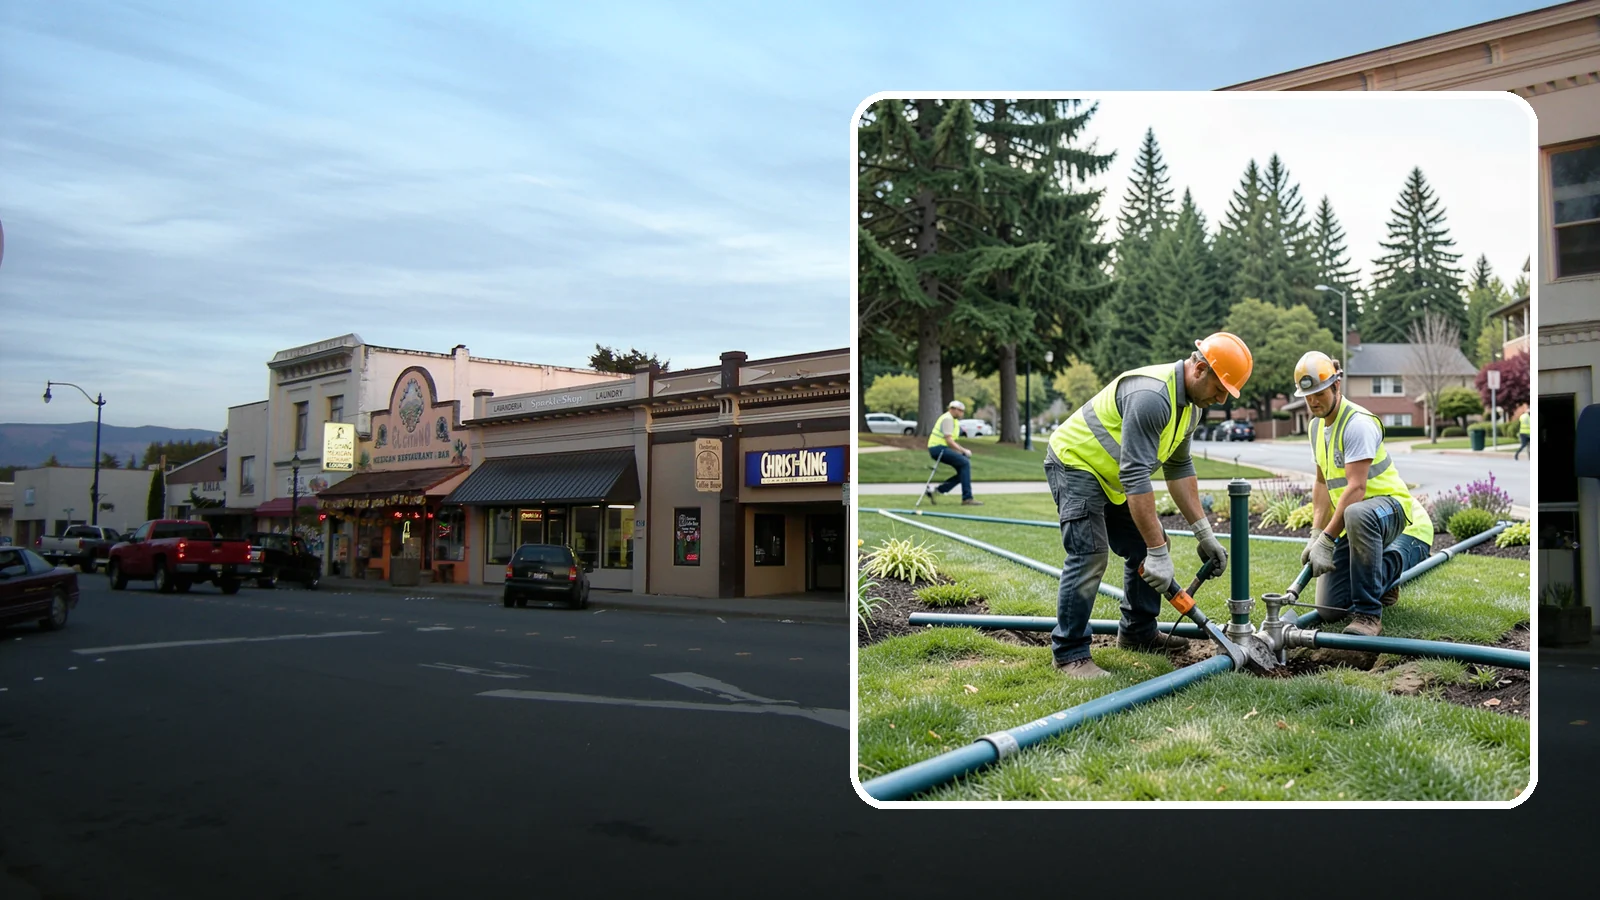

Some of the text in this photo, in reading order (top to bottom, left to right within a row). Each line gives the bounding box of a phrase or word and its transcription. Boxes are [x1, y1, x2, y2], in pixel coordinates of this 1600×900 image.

[562, 394, 582, 403] Shop
[595, 389, 623, 399] LAUNDRY
[493, 402, 523, 412] LAVANDERIA
[373, 455, 396, 464] MEXICAN
[397, 451, 433, 462] RESTAURANT
[437, 450, 450, 459] BAR
[760, 450, 828, 478] CHRIST KING
[696, 480, 709, 489] Coffee
